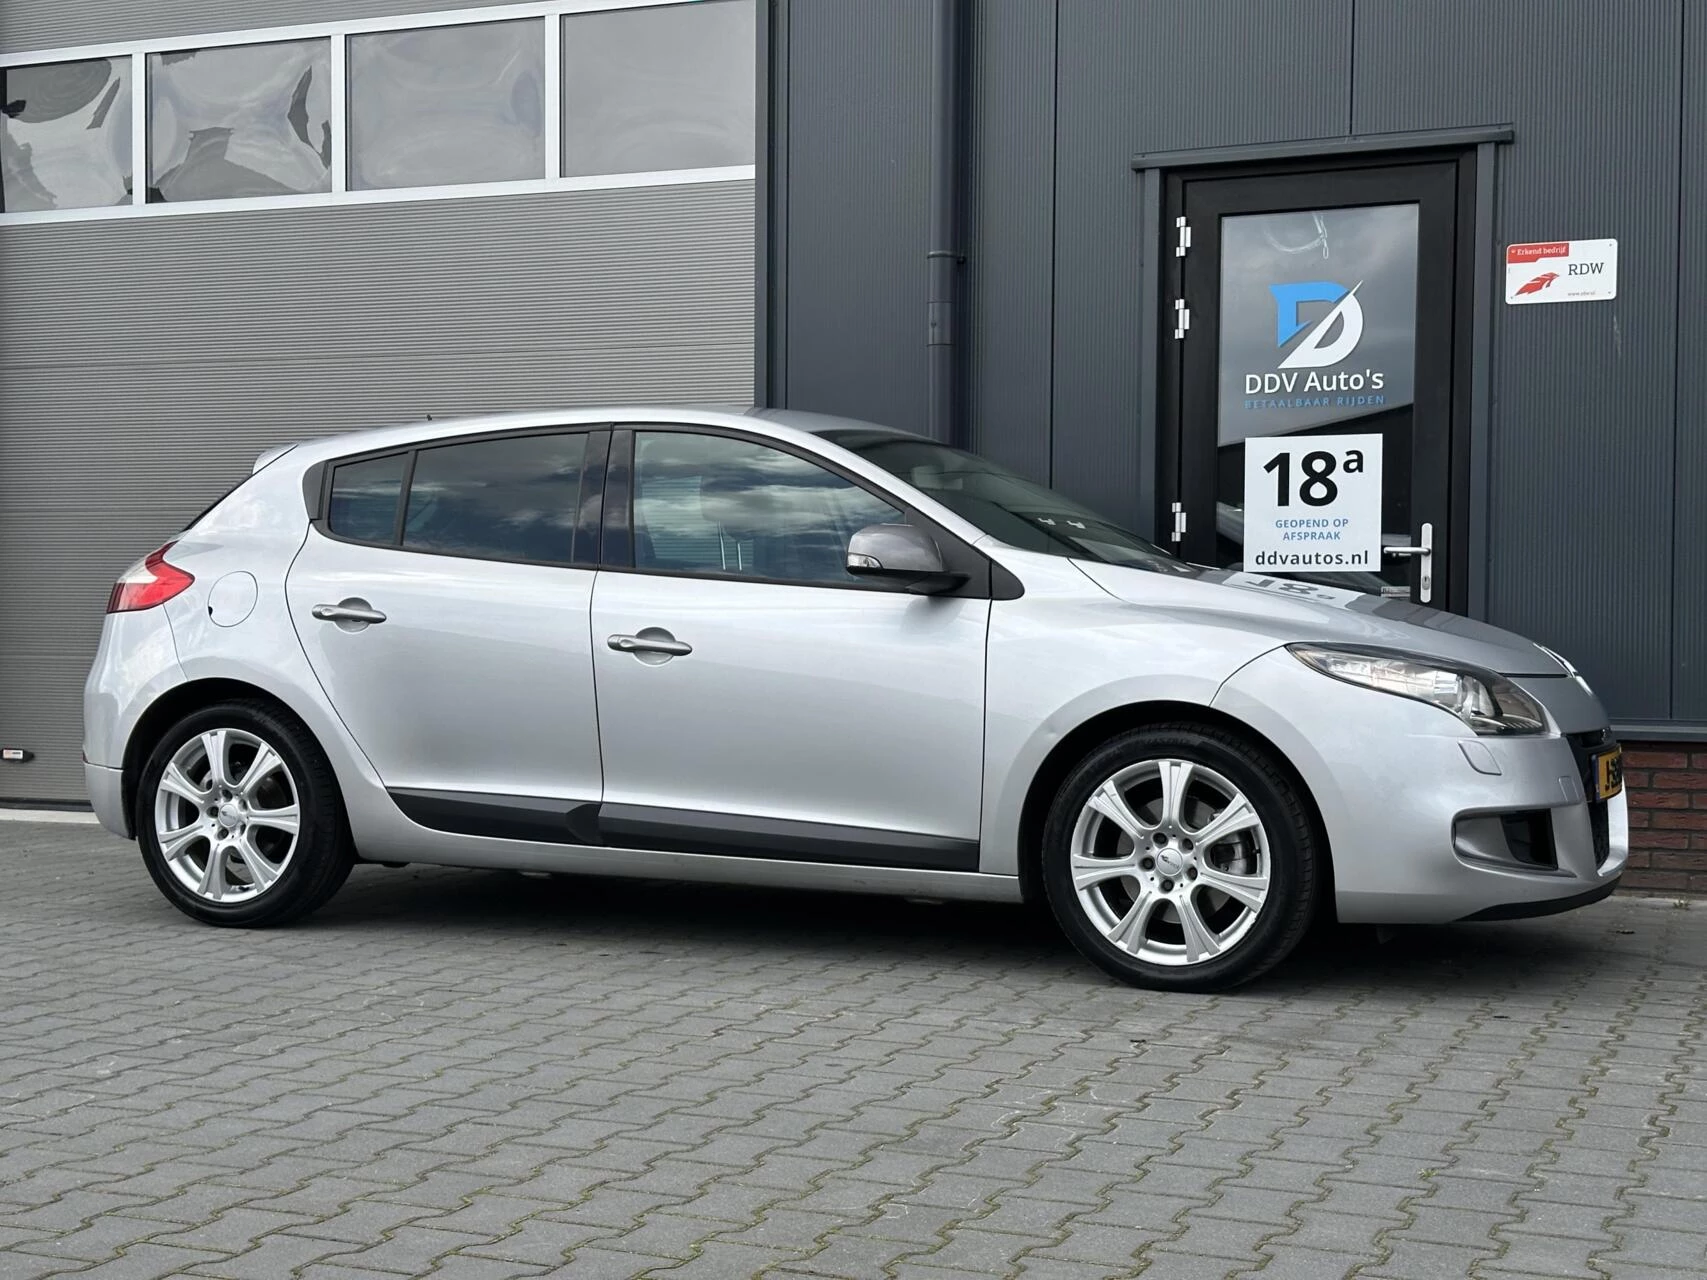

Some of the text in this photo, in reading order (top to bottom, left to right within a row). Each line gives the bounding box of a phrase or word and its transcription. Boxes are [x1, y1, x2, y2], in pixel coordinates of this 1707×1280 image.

[1568, 262, 1605, 276] RDW
[1245, 369, 1384, 394] DDV Auto's
[1244, 395, 1385, 409] BETAALBAAR RIJDEN
[1275, 518, 1349, 529] GEOPEND OP
[1282, 531, 1341, 541] AFSPRAAK
[1255, 550, 1368, 566] ddvautos.nl
